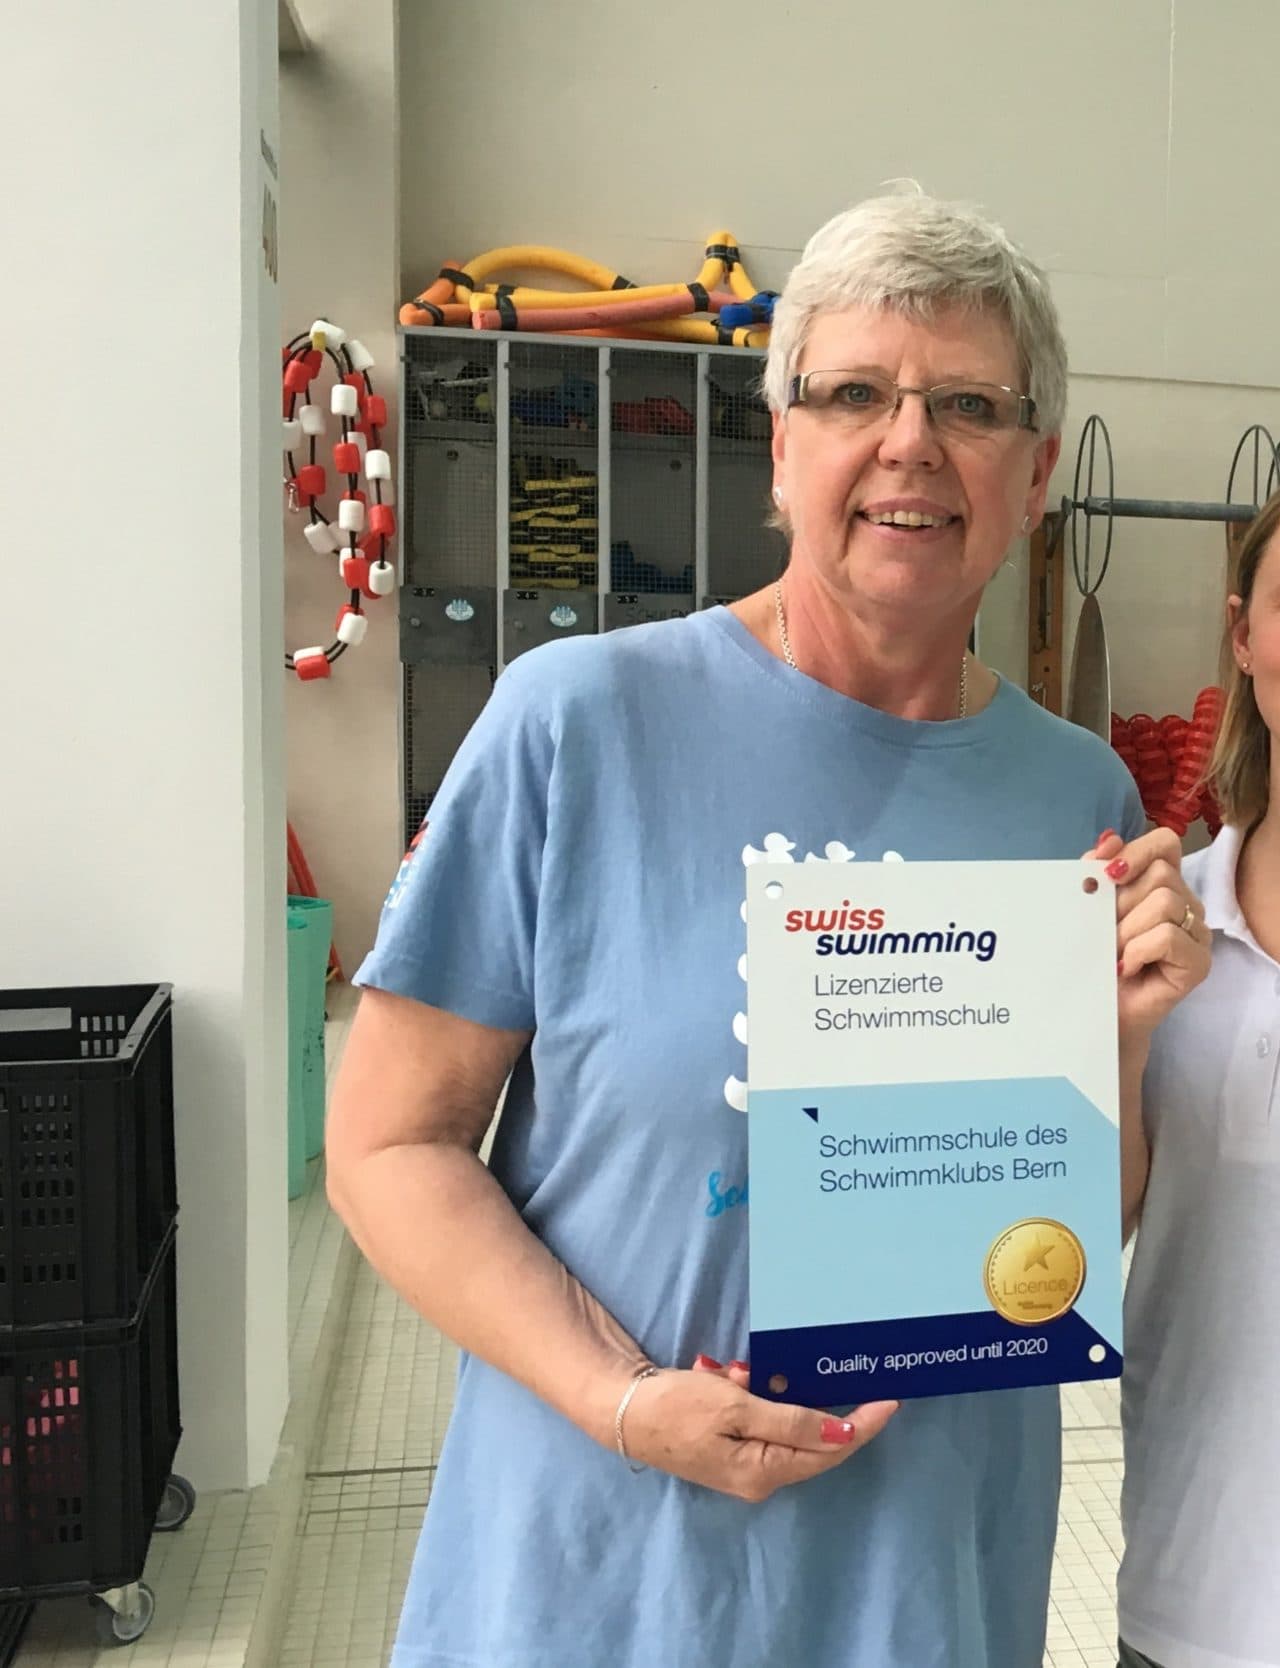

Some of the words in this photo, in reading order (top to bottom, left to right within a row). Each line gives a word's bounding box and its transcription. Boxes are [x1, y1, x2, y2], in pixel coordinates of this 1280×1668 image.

[784, 899, 886, 933] swiss
[815, 922, 998, 962] swimming
[814, 972, 944, 996] Lizenzierte
[814, 1002, 1011, 1031] Schwimmschule
[819, 1126, 1018, 1158] Schwimmschule
[1025, 1124, 1068, 1146] des
[819, 1161, 1004, 1193] Schwimmklubs
[1012, 1157, 1067, 1180] Bern
[1003, 1279, 1067, 1296] Licence
[816, 1354, 879, 1375] Quality
[883, 1345, 968, 1371] approved
[971, 1341, 1003, 1360] until
[1006, 1337, 1048, 1357] 2020
